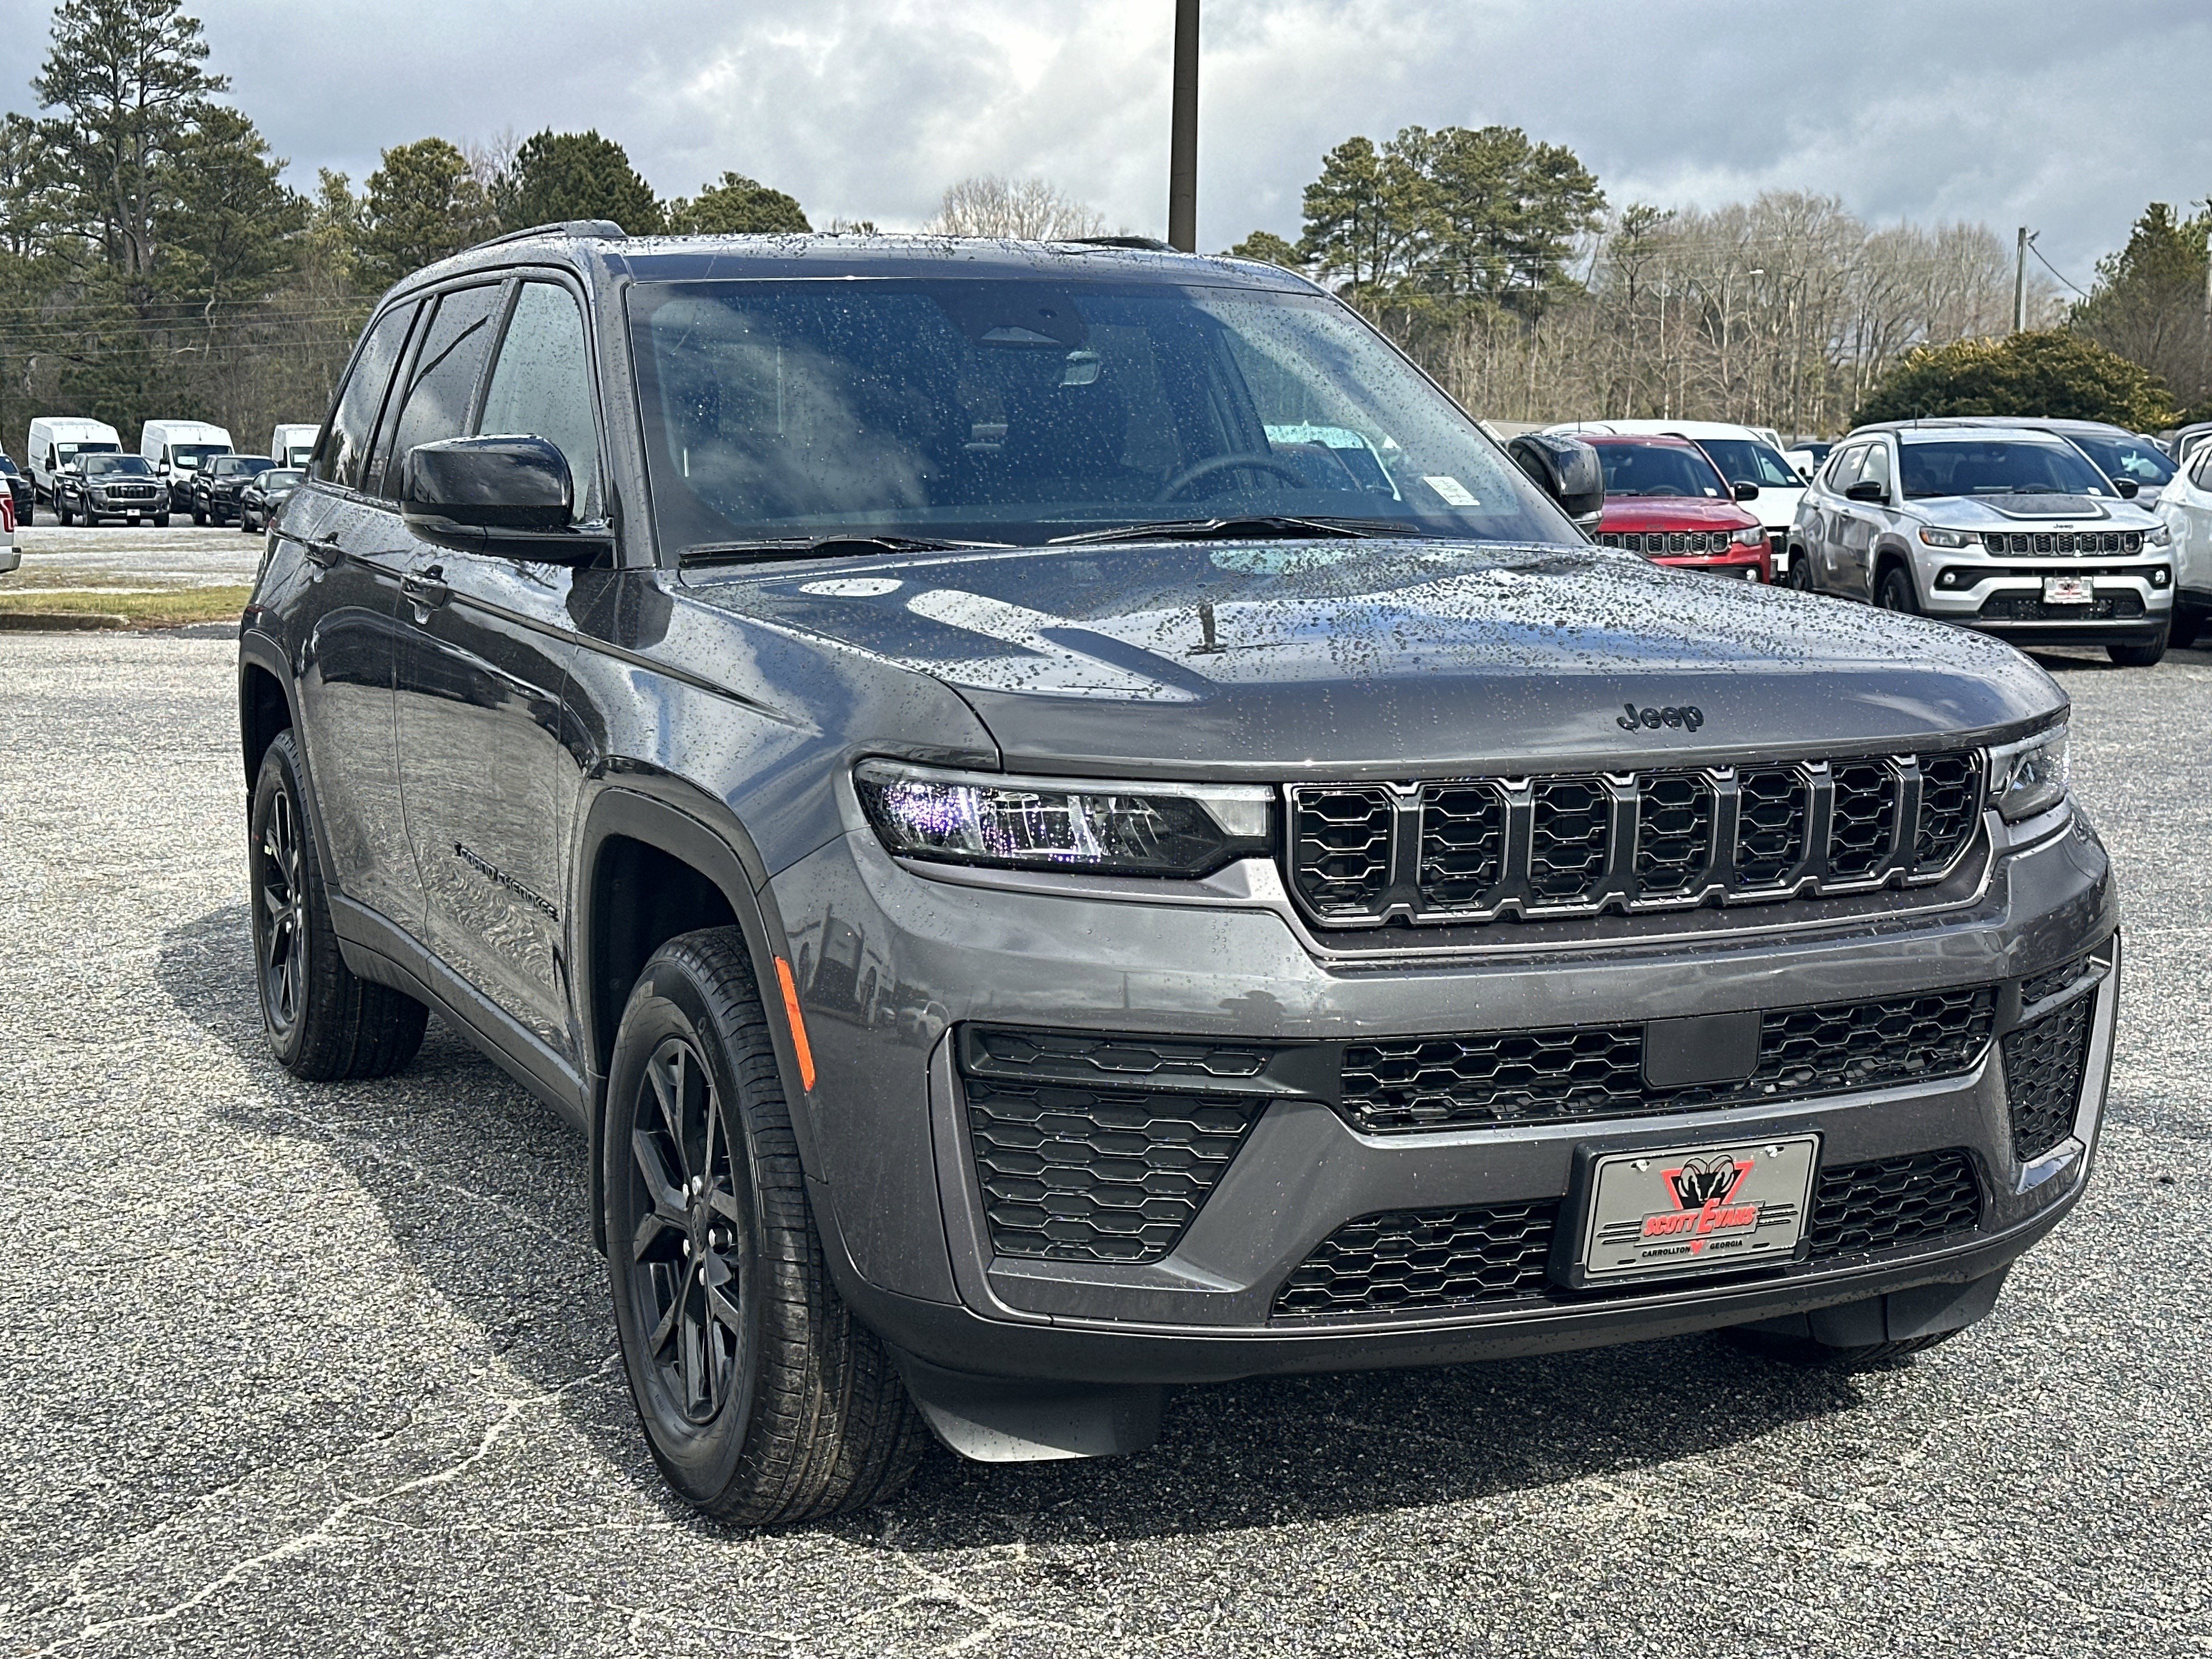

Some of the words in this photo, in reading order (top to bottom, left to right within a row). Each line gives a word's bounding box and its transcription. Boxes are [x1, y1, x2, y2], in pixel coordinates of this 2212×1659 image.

[1616, 703, 1704, 732] Jeep
[1644, 1213, 1699, 1237] SCOTT
[1696, 1198, 1756, 1234] EVANS
[1642, 1246, 1691, 1257] CARROLLTON
[1709, 1240, 1742, 1250] GEORGIA
